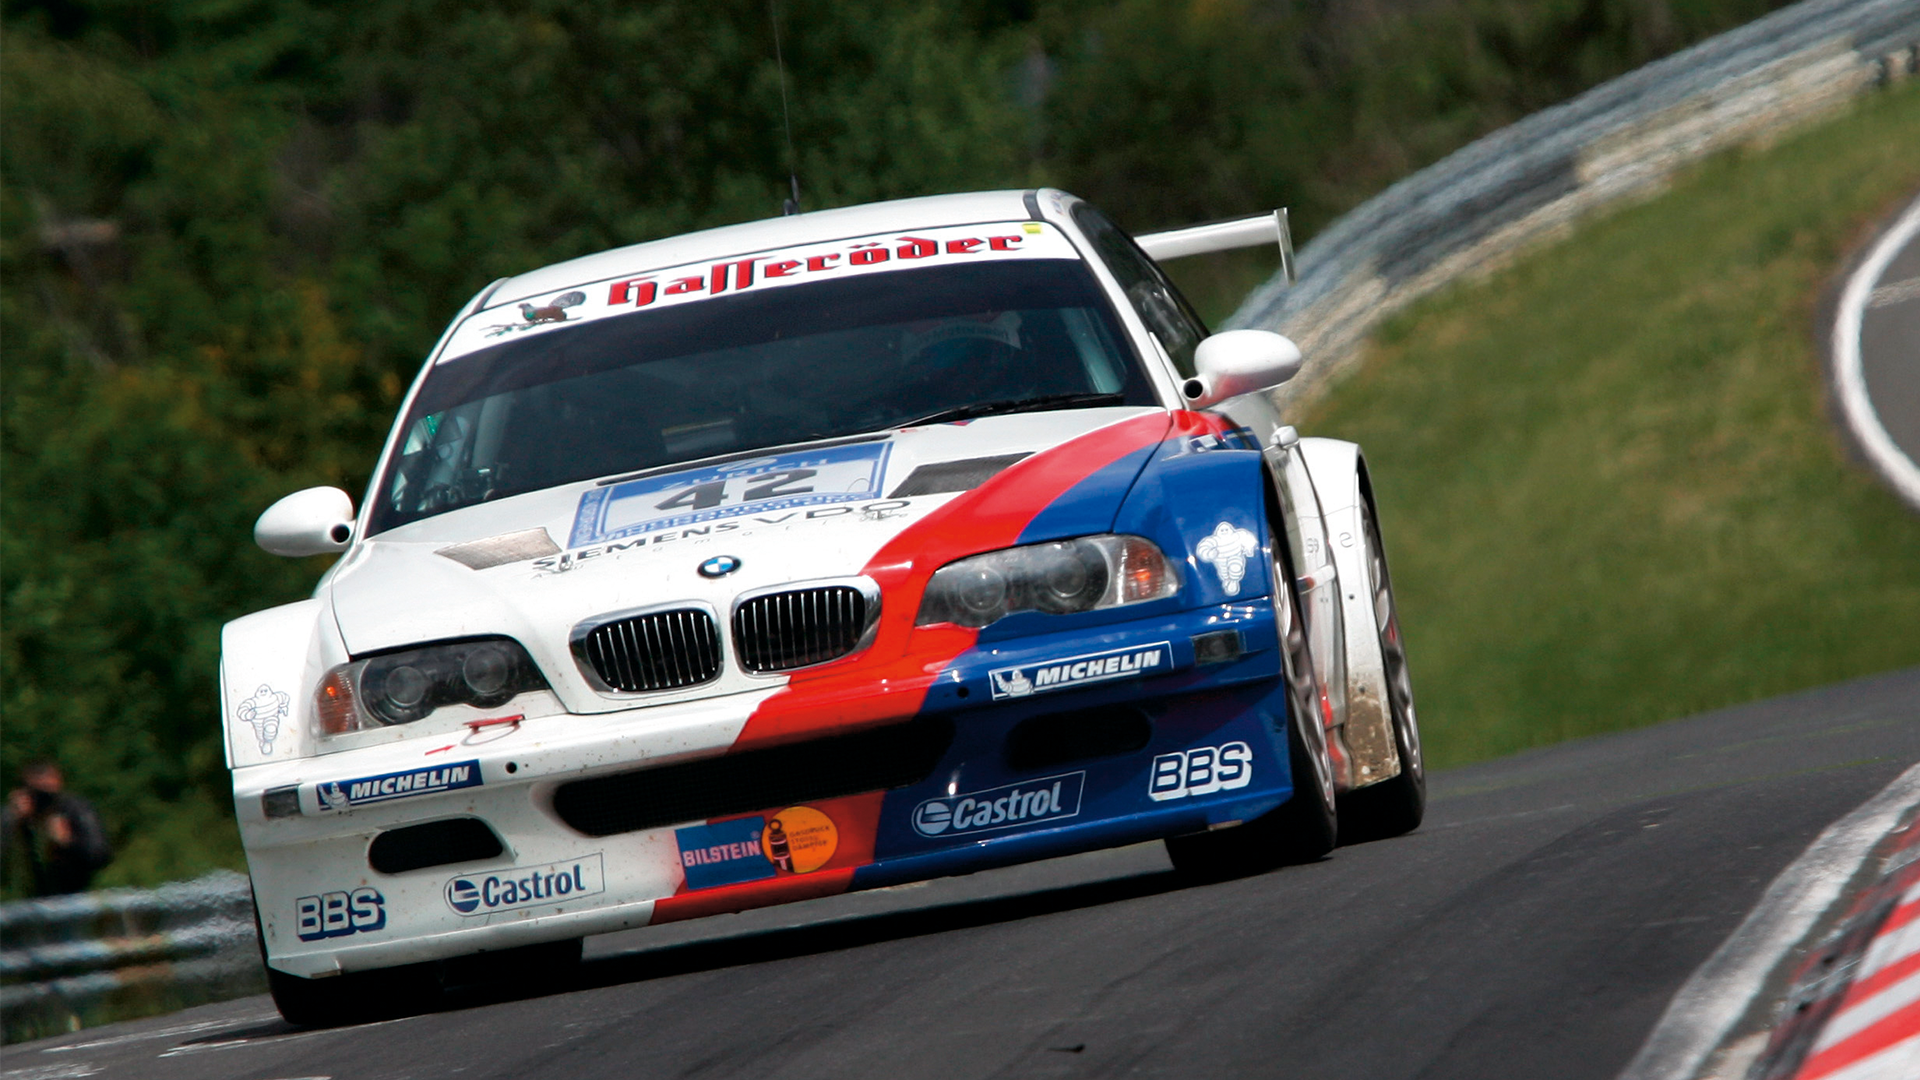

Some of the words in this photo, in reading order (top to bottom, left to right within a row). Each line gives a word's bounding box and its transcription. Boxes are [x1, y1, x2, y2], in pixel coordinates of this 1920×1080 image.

[654, 468, 817, 511] 42
[532, 520, 740, 570] SIEMENS
[753, 500, 911, 524] VDO
[1035, 649, 1163, 686] MICHELIN
[350, 764, 471, 800] MICHELIN
[1148, 741, 1253, 801] BBS
[952, 781, 1062, 830] Castrol
[682, 839, 762, 867] BILSTEIN
[482, 864, 586, 908] Castrol
[296, 886, 386, 942] BBS
